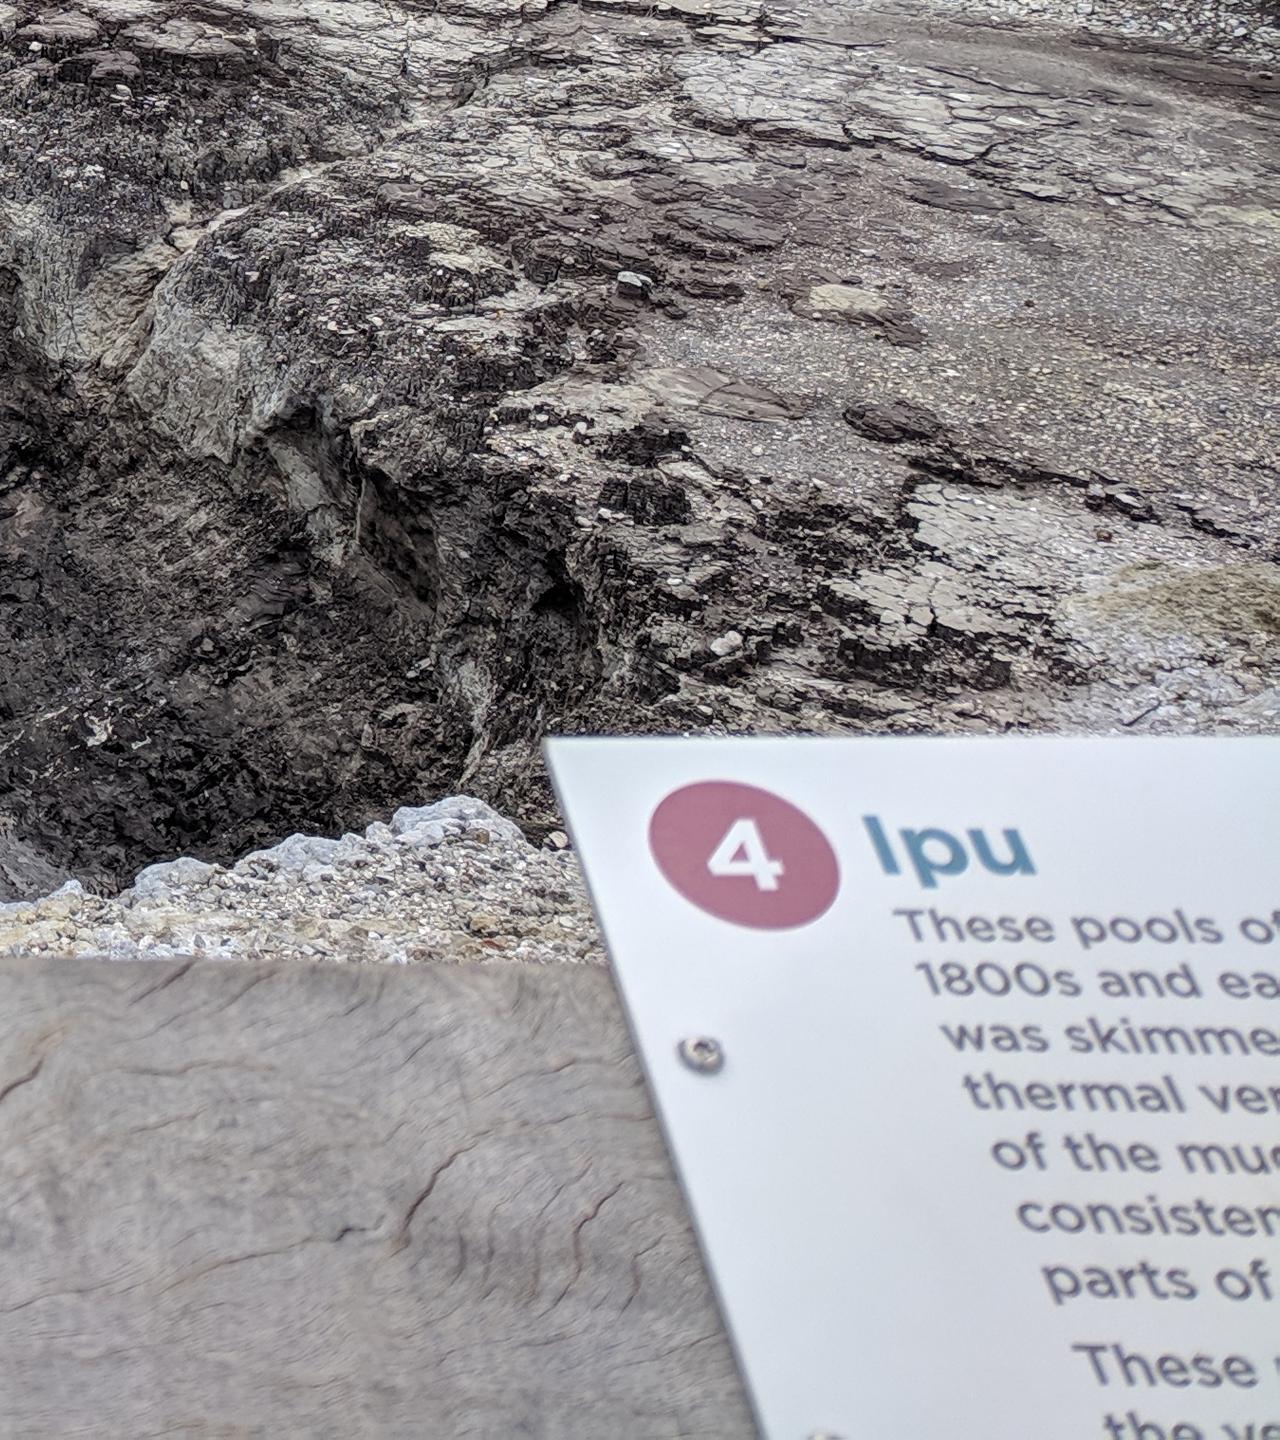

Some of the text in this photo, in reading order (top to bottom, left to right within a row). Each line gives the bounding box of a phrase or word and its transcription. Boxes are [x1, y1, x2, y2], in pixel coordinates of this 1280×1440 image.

[707, 815, 1037, 891] 4 Ipu
[893, 908, 1055, 944] These
[1071, 909, 1224, 949] pools
[915, 961, 1082, 998] 1800s
[1097, 963, 1202, 998] and
[939, 1016, 1280, 1056] was skimme
[962, 1072, 1186, 1113] thermal
[991, 1131, 1280, 1175] of the mu
[1041, 1258, 1273, 1305] parts of
[1071, 1343, 1258, 1388] These
